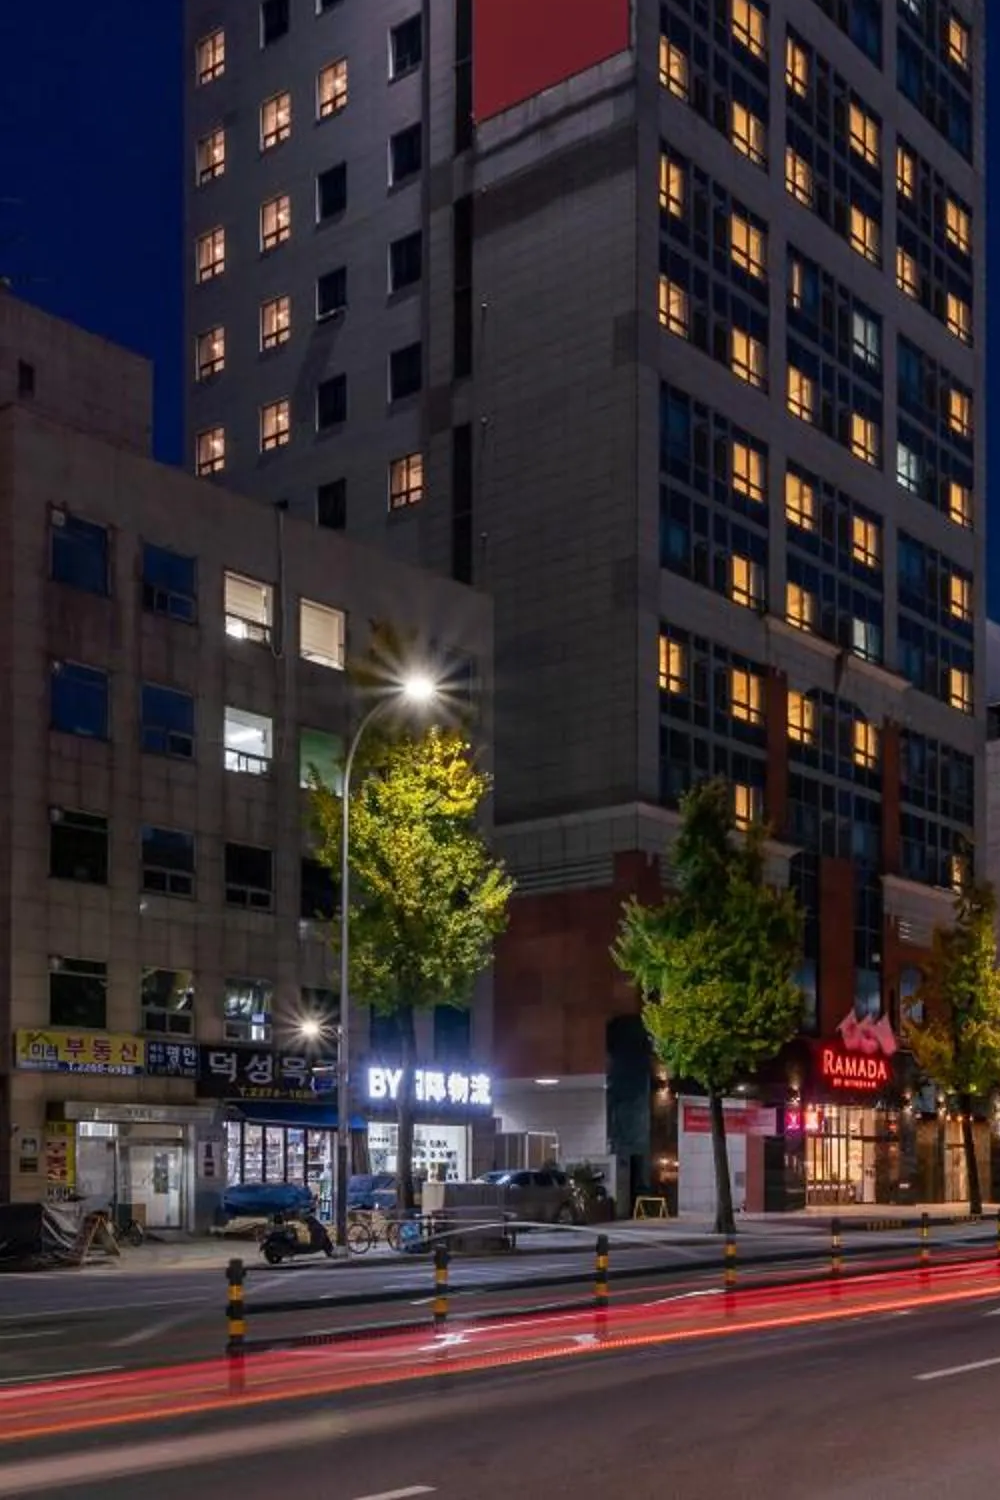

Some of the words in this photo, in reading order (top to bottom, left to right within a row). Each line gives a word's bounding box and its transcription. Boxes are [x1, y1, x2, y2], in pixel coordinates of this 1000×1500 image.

[64, 1037, 138, 1063] 부동산
[823, 1049, 887, 1080] RAMADA
[369, 1067, 403, 1099] BY
